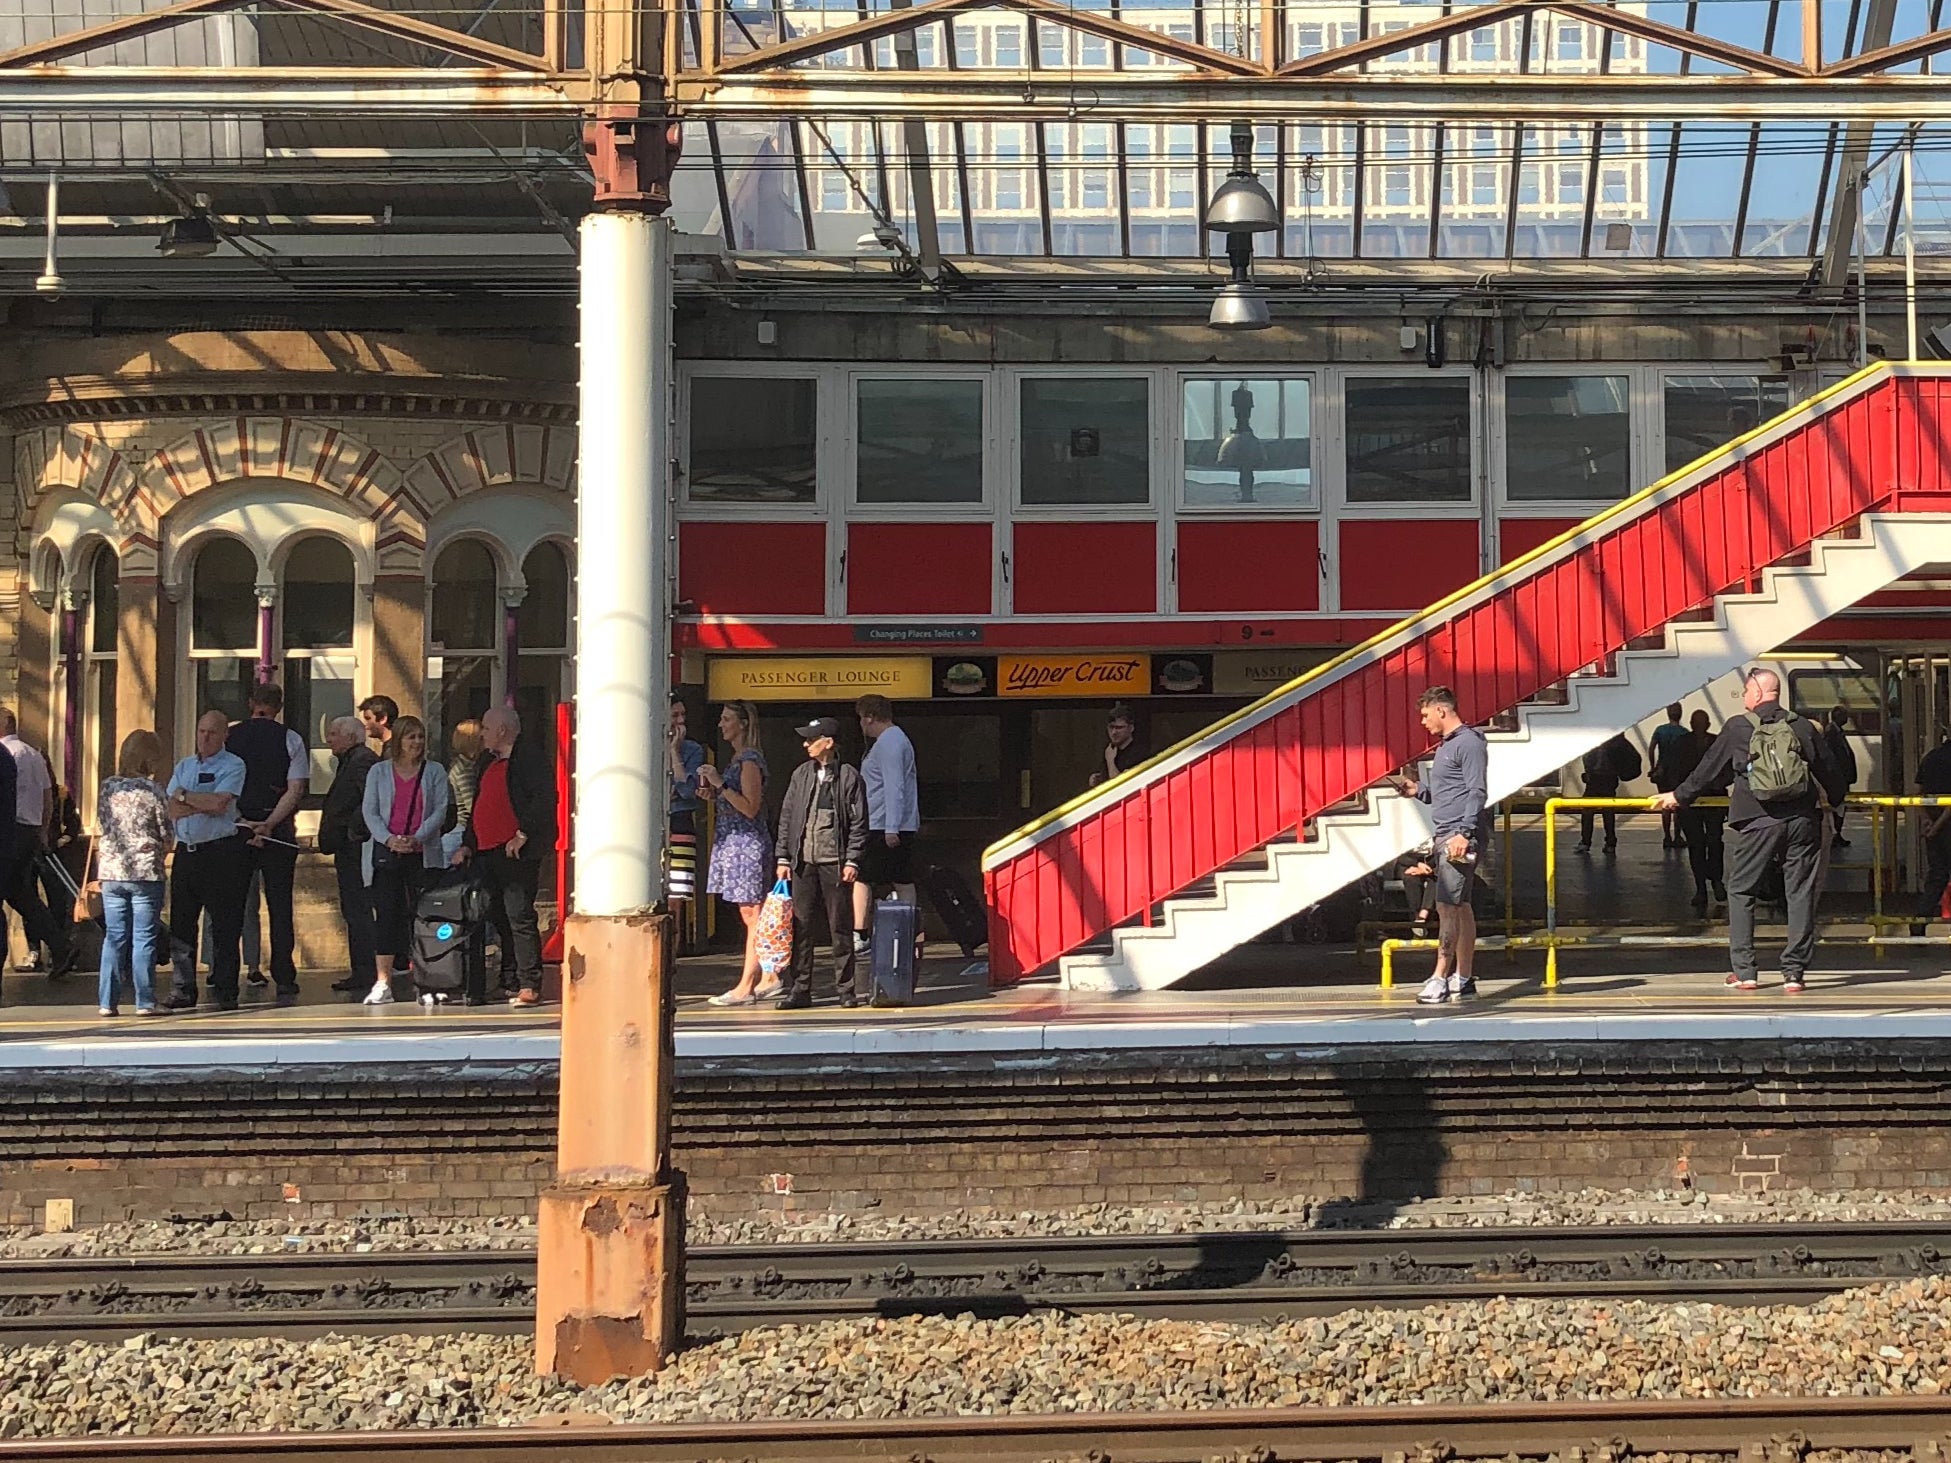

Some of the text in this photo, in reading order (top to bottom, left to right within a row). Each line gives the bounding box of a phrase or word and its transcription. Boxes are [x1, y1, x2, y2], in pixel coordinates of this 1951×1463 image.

[869, 629, 956, 640] Changing Places Toilet
[1241, 624, 1253, 640] 9
[740, 670, 901, 684] PASSENGER LOUNGE
[1007, 663, 1074, 688] Upper
[1075, 660, 1141, 683] Crust
